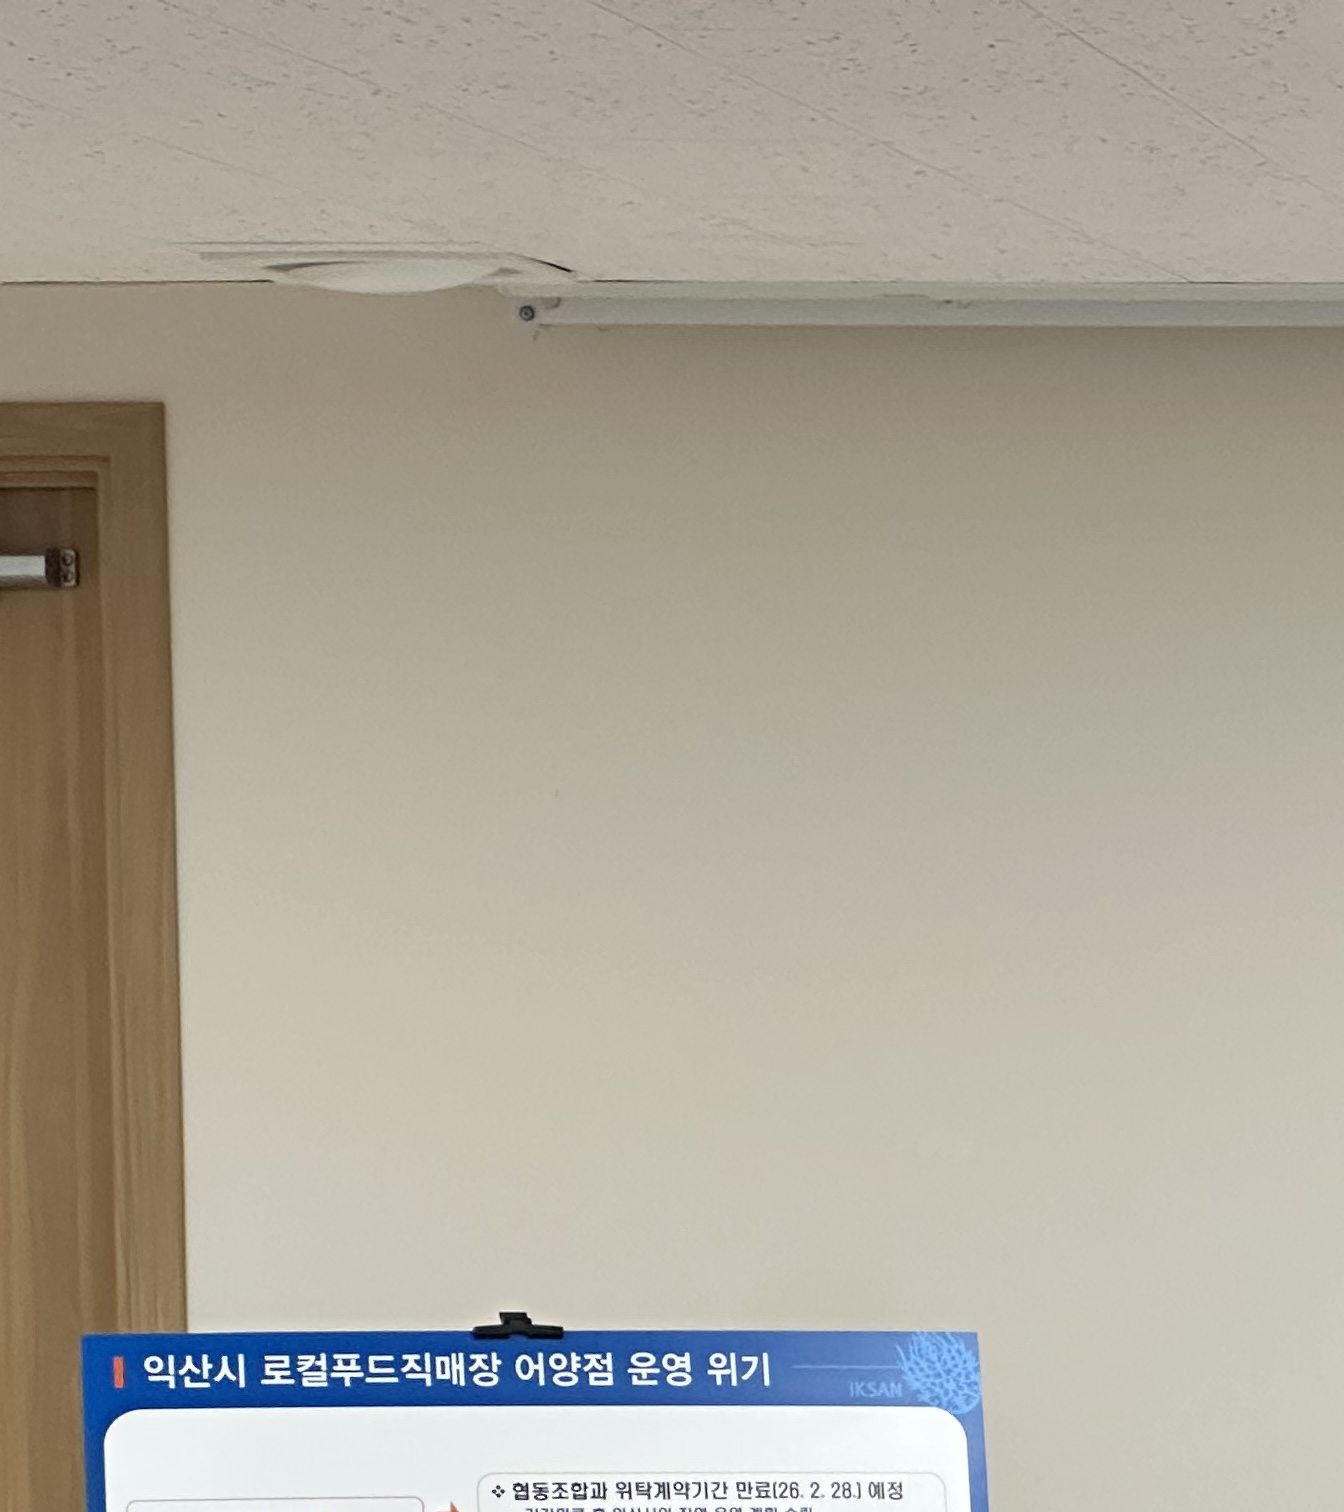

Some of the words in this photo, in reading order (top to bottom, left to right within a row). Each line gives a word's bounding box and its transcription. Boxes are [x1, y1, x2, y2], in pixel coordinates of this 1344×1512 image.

[143, 1354, 246, 1389] 익산시
[260, 1352, 502, 1387] 로컬푸드직매장
[514, 1352, 614, 1387] 어양점
[626, 1352, 693, 1387] 운영
[707, 1352, 771, 1387] 위기
[849, 1381, 902, 1398] IKSAN
[512, 1482, 608, 1501] 협동조합과
[615, 1481, 728, 1500] 위탁계약기간
[868, 1481, 903, 1501] 예정
